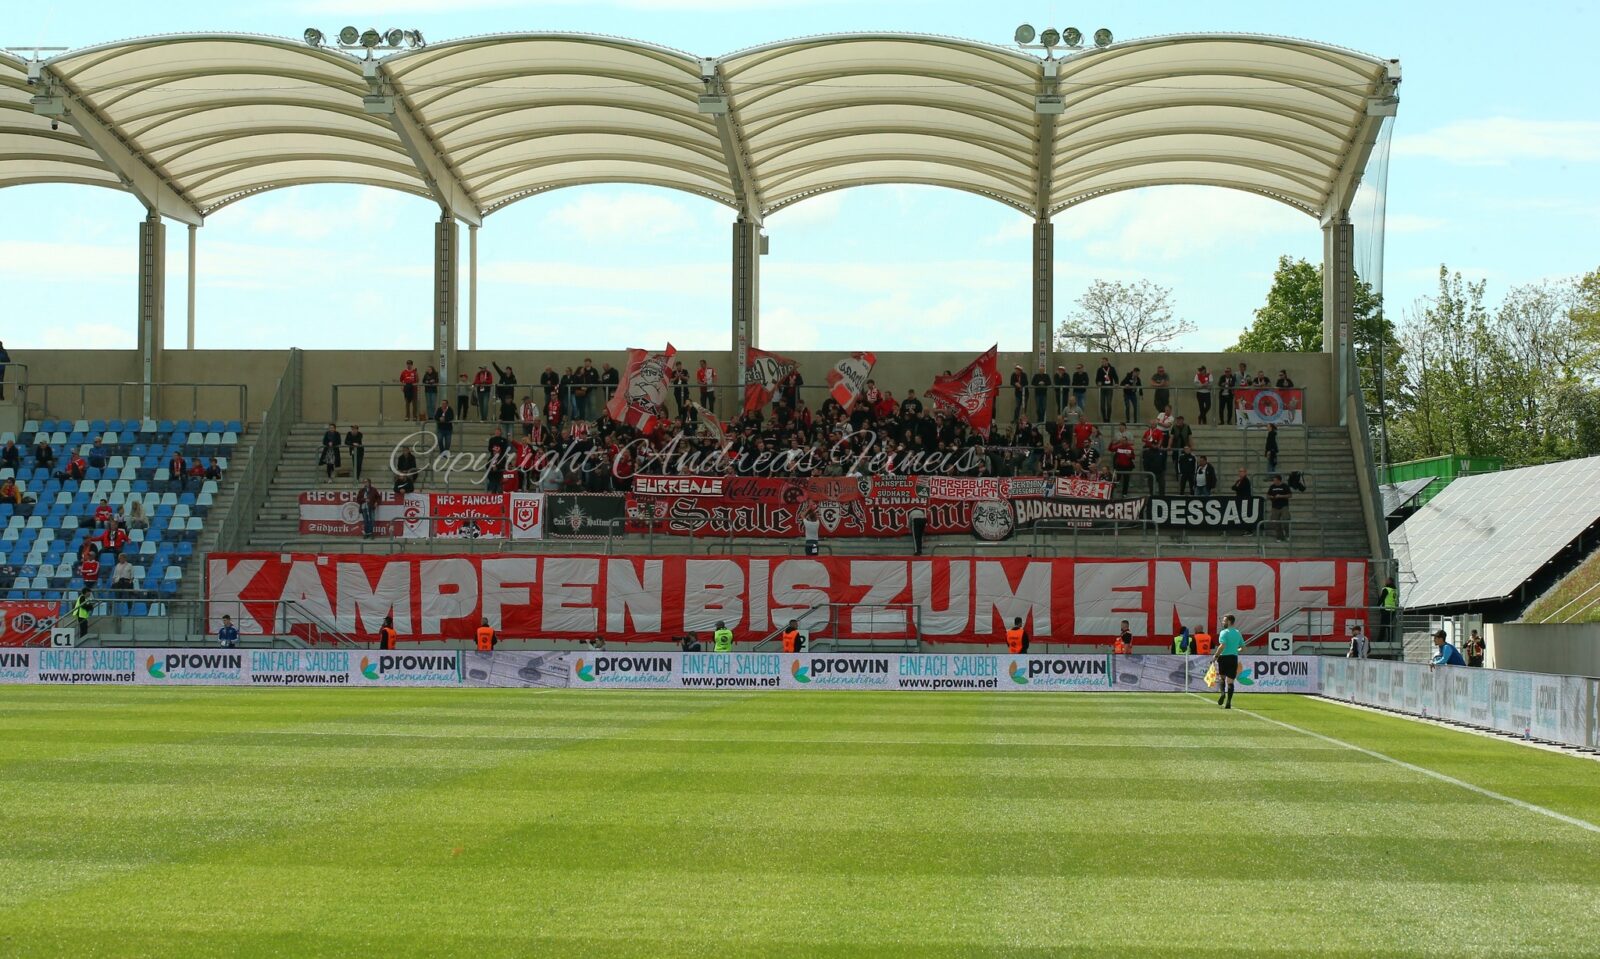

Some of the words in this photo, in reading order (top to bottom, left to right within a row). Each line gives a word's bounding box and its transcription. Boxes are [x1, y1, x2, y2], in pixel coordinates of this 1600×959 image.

[636, 478, 723, 494] SURREALE
[874, 480, 914, 488] MANSFELD
[307, 491, 335, 502] HFC
[437, 494, 456, 505] HFC
[462, 494, 504, 505] FANCLUB
[669, 497, 793, 534] Saale
[1015, 497, 1145, 525] BADKURVEN-CREW
[1151, 498, 1260, 525] DESSAU
[208, 554, 663, 635] KÄMPFEN
[683, 558, 831, 634] BIS
[849, 559, 1053, 636] ZUM
[53, 633, 73, 647] C1
[1270, 637, 1291, 651] C3
[38, 650, 87, 671] EINFACH
[92, 650, 136, 671] SAUBER
[251, 651, 300, 672] EINFACH
[304, 651, 350, 672] SAUBER
[682, 654, 732, 675] EINFACH
[736, 654, 781, 675] SAUBER
[899, 655, 948, 676] EINFACH
[953, 655, 998, 676] SAUBER
[169, 669, 241, 681] international
[383, 670, 456, 682] international
[599, 671, 672, 684] international
[815, 673, 889, 685] international
[1033, 675, 1106, 687] international
